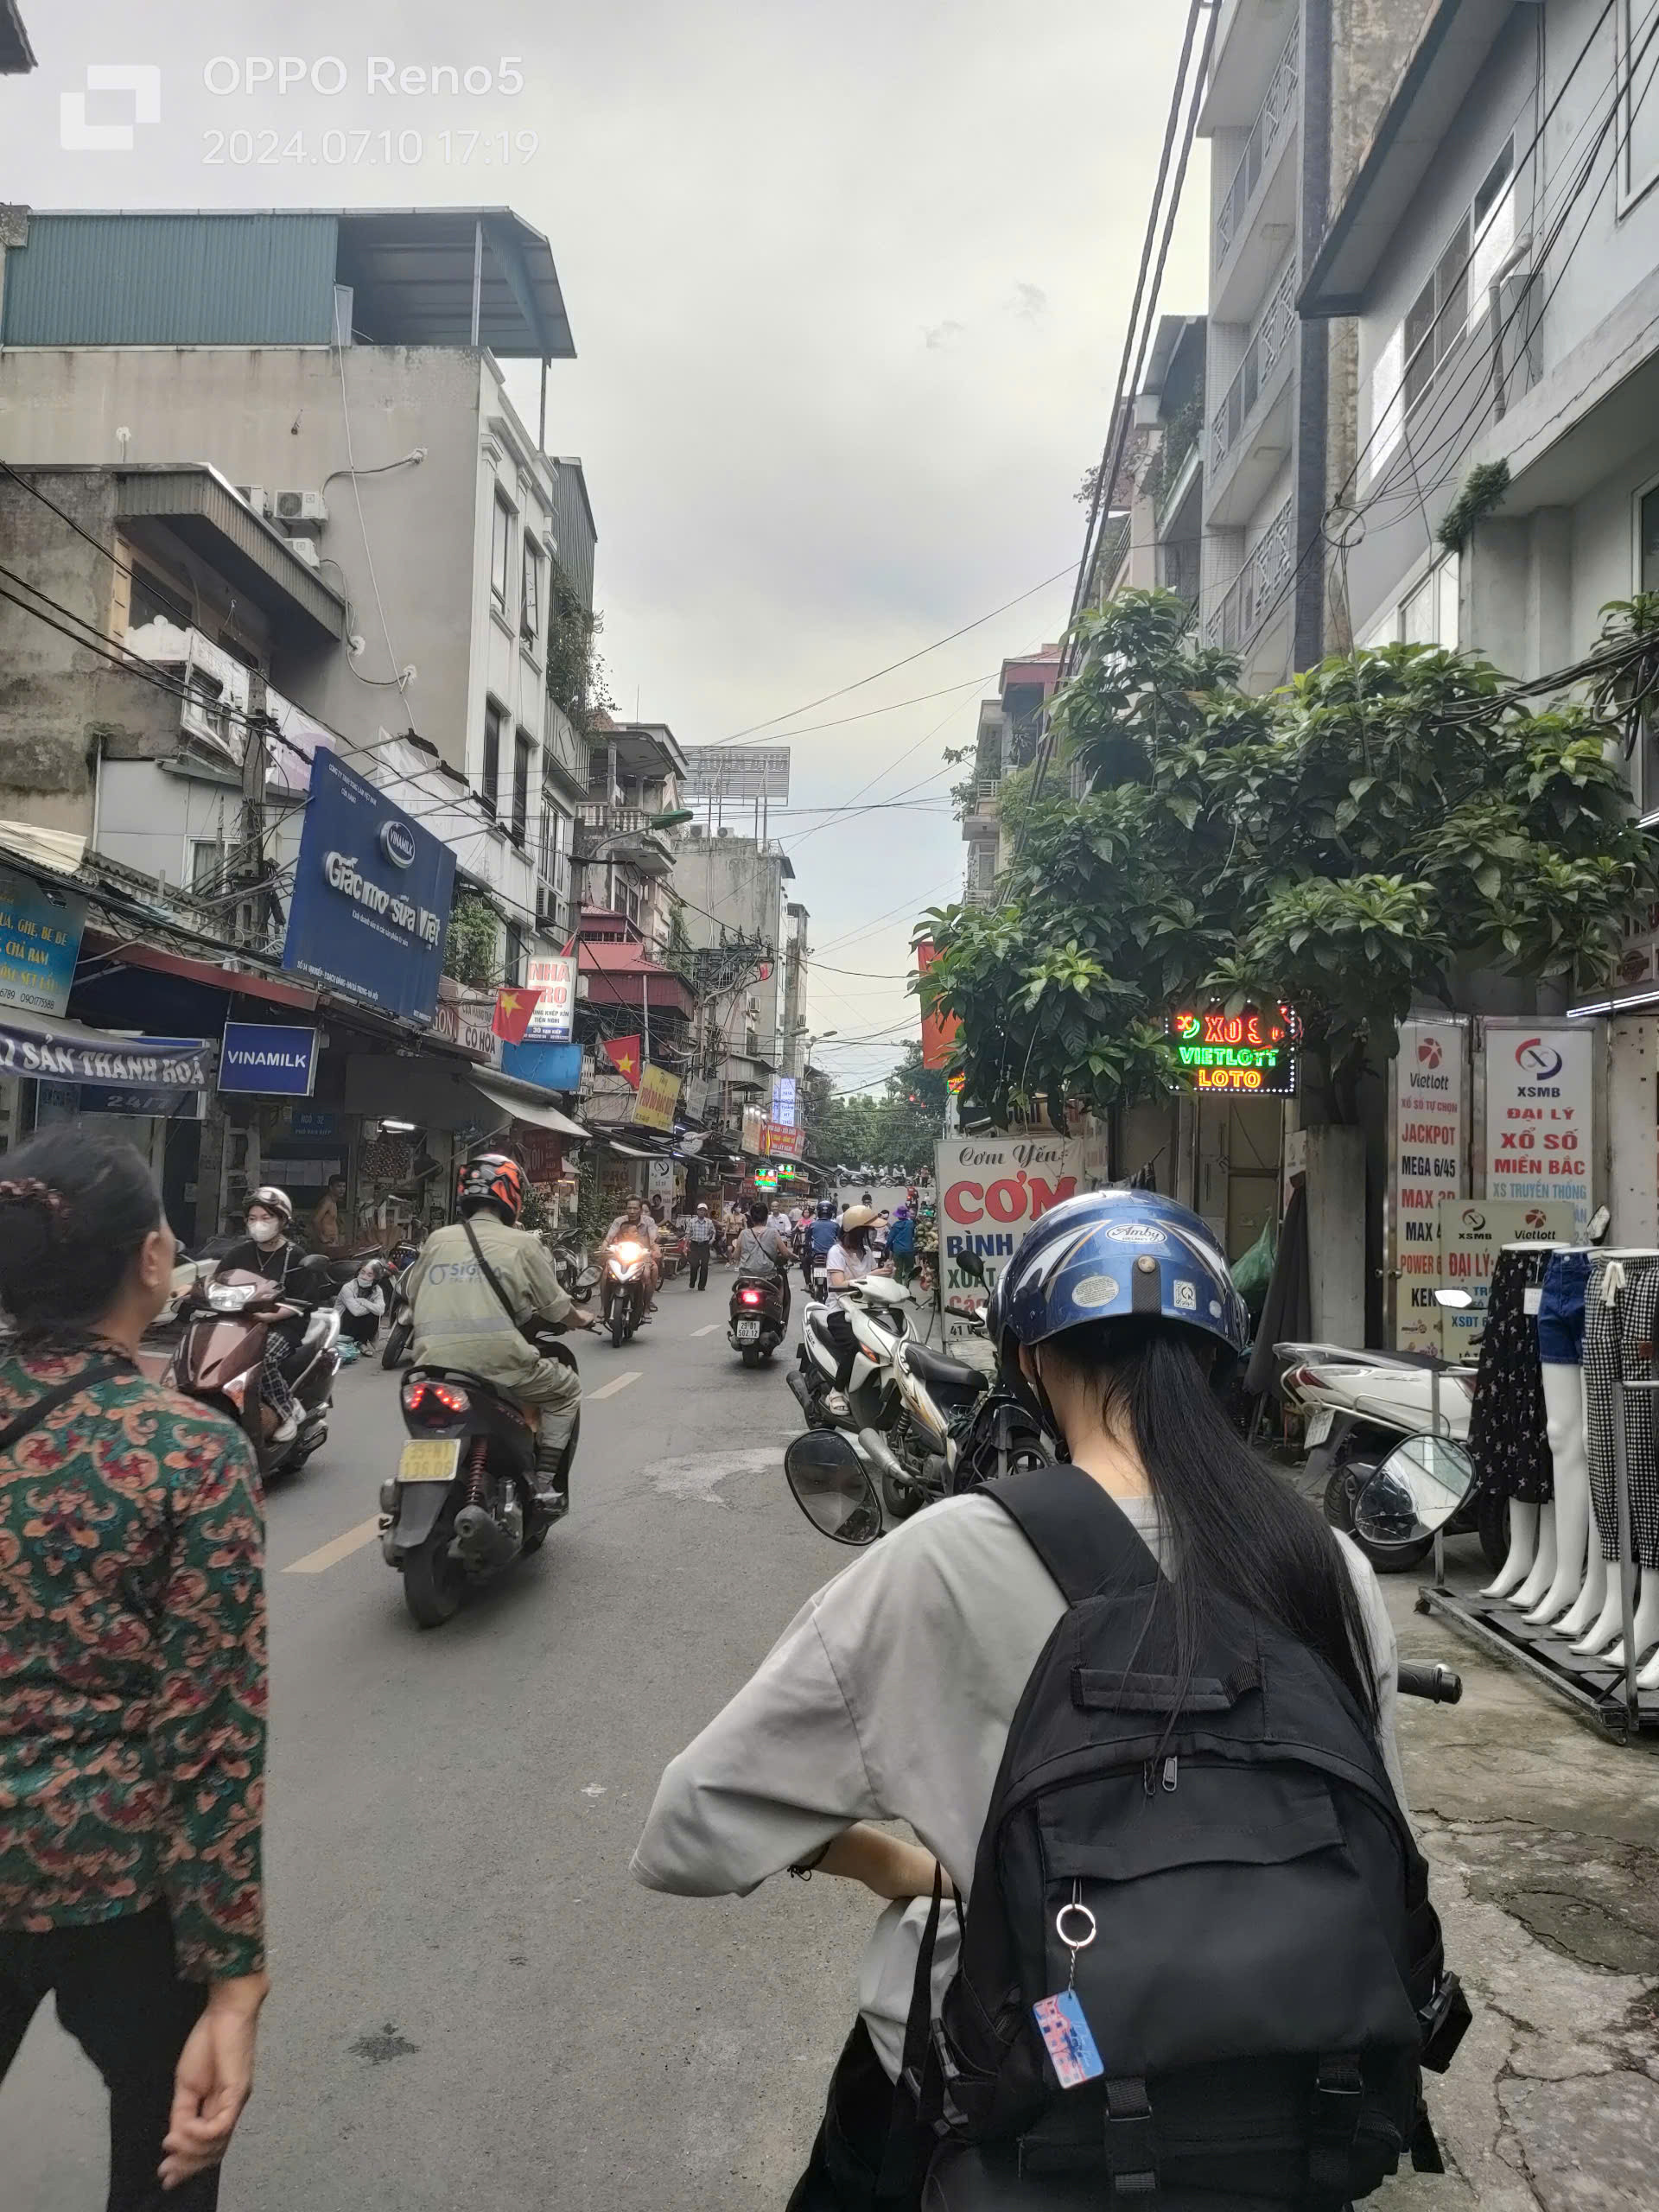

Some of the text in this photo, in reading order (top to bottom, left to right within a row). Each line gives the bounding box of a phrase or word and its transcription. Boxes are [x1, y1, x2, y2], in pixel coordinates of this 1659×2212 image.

[389, 828, 413, 859] VINAMILK
[325, 851, 441, 951] Giấc mơ sữa Việt
[528, 960, 570, 982] NHÀ
[22, 1033, 76, 1075] SẢN
[79, 1050, 158, 1082] THANH
[227, 1050, 307, 1069] VINAMILK
[1198, 1068, 1261, 1088] LOTO
[1409, 1072, 1449, 1091] Vietlott
[1517, 1086, 1560, 1098] XSMB
[1507, 1106, 1575, 1122] ĐẠI LÝ
[1402, 1122, 1456, 1146] JACKPOT
[1500, 1127, 1579, 1150] XỔ SỐ
[959, 1144, 1060, 1168] Cơm Yến
[1402, 1155, 1456, 1178] MEGA 6/45
[1494, 1154, 1586, 1175] MIỀN BẮC
[944, 1170, 1077, 1225] CƠM
[1402, 1188, 1433, 1209] MAX
[1493, 1179, 1587, 1199] XS TRUYỀN THỐNG
[1111, 1225, 1160, 1241] Amby
[1406, 1222, 1433, 1242] MAX
[1515, 1230, 1556, 1241] Vietlott
[946, 1230, 1014, 1258] BÌNH
[1400, 1254, 1433, 1274] POWER
[1448, 1252, 1472, 1282] ĐẠI
[1411, 1287, 1436, 1307] KEN
